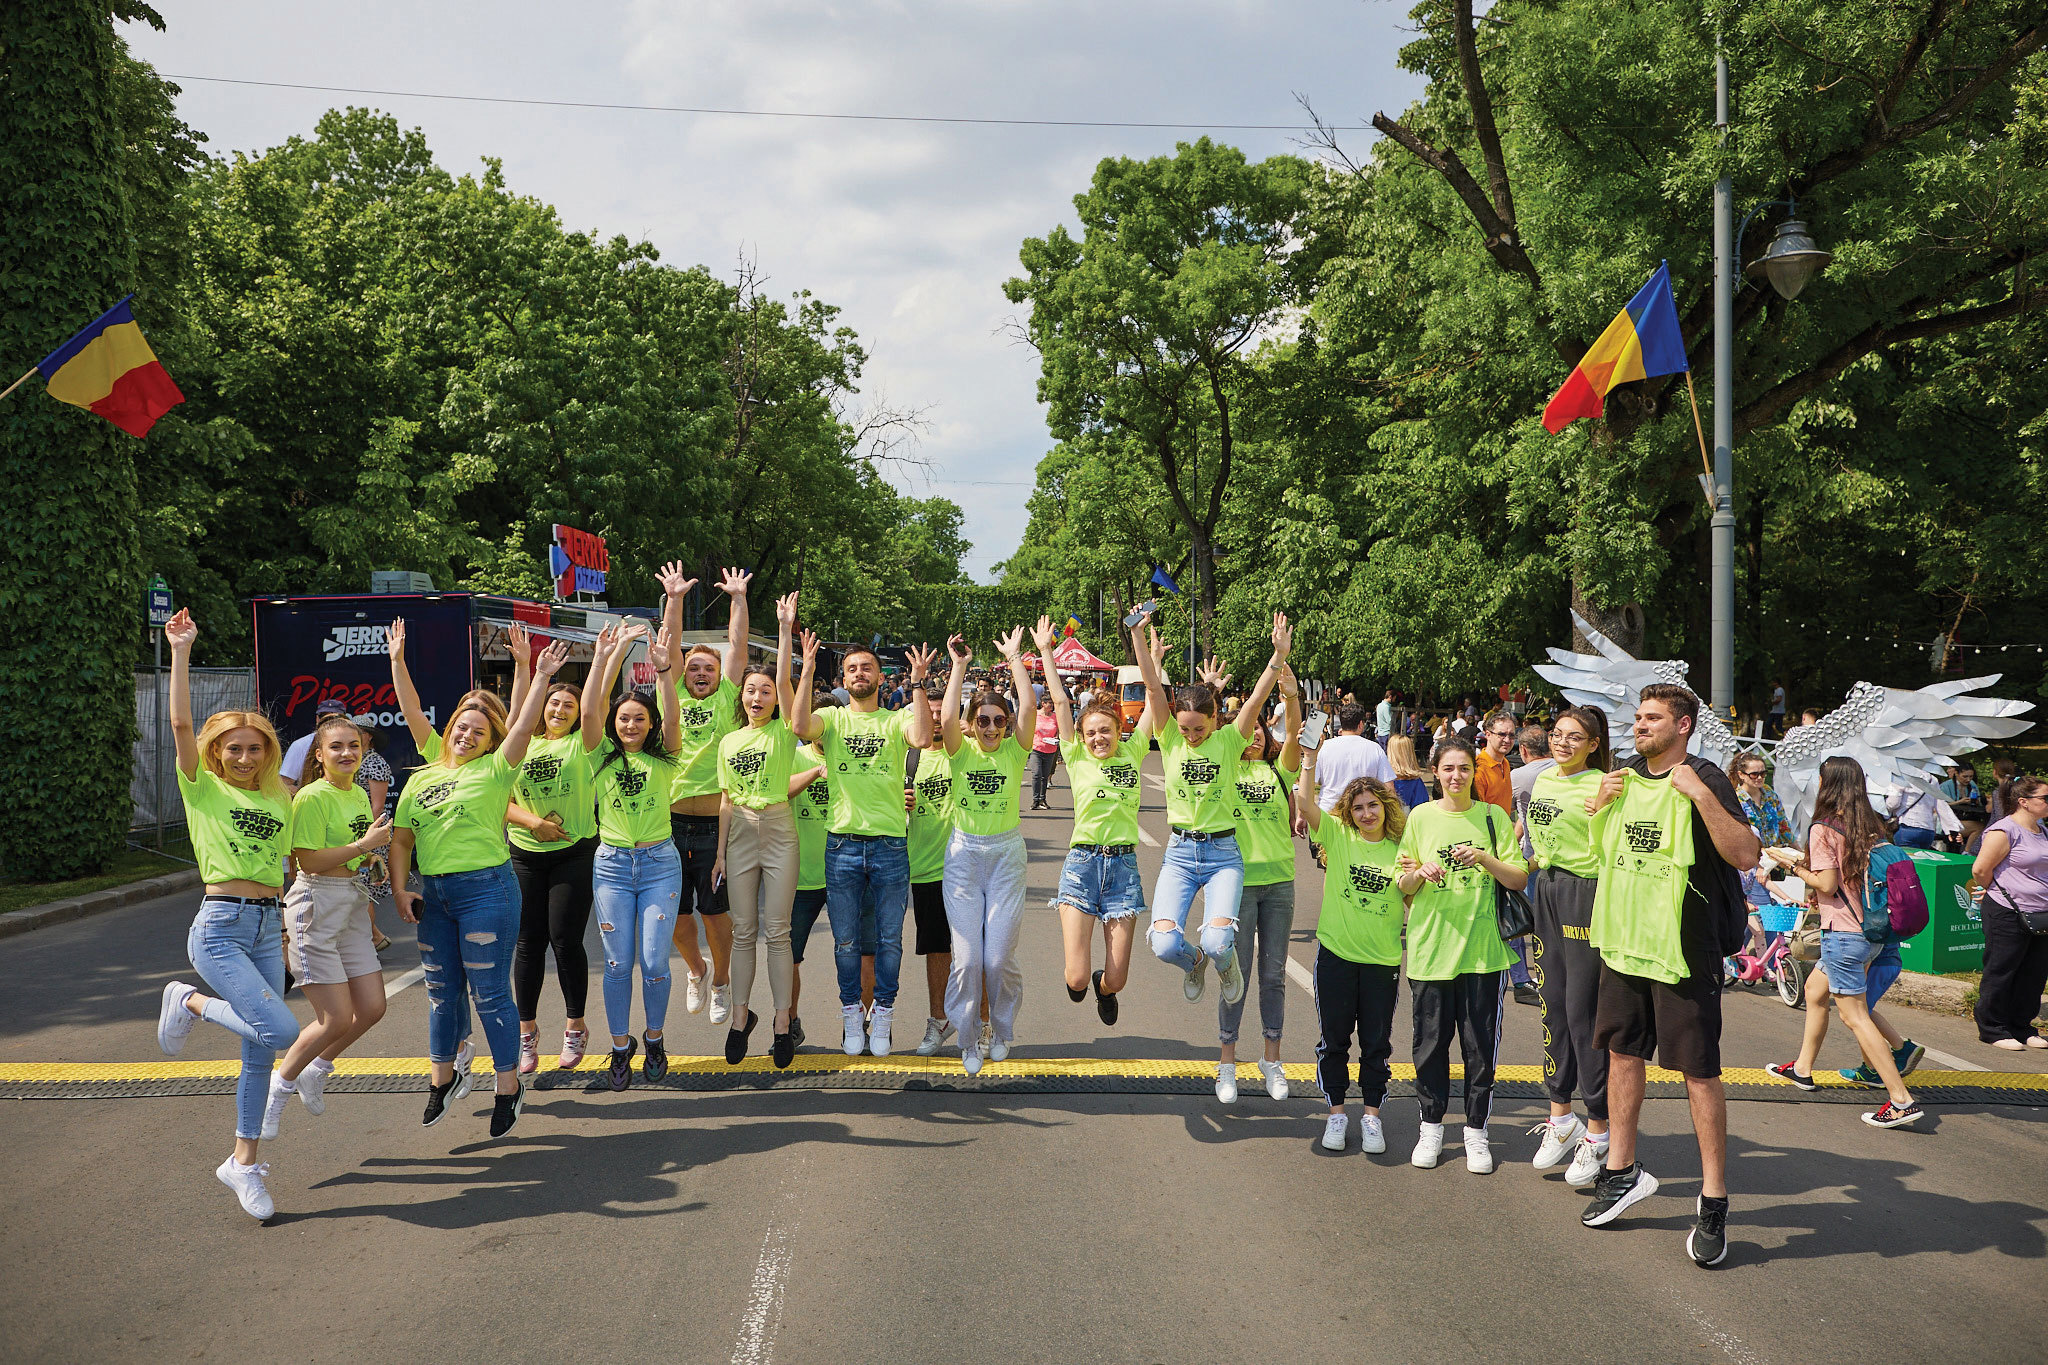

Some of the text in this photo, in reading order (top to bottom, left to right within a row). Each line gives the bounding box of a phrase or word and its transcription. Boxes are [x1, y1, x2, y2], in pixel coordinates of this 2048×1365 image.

[286, 675, 397, 717] Pizza
[844, 737, 886, 747] STREET
[522, 758, 563, 770] STREET
[727, 752, 767, 765] STREET
[734, 761, 761, 772] FOOD
[527, 768, 558, 778] FOOD
[966, 772, 1007, 785] STREET
[1100, 768, 1138, 778] STREE
[1182, 772, 1215, 780] FOOD
[917, 778, 952, 789] STREET
[970, 782, 999, 790] FOOD
[1107, 775, 1138, 785] FOOD
[807, 785, 829, 794] STR
[922, 787, 948, 796] FOOD
[1235, 782, 1276, 794] STREET
[1241, 790, 1271, 799] FOOD
[229, 810, 284, 832] STREET
[1530, 810, 1552, 822] FOOD
[236, 820, 275, 836] FOOD
[1624, 823, 1663, 839] STREE
[1627, 835, 1661, 849] FOOD
[1349, 864, 1393, 886] STREET
[1351, 876, 1384, 890] FOOD
[1562, 924, 1591, 941] NIRVAN
